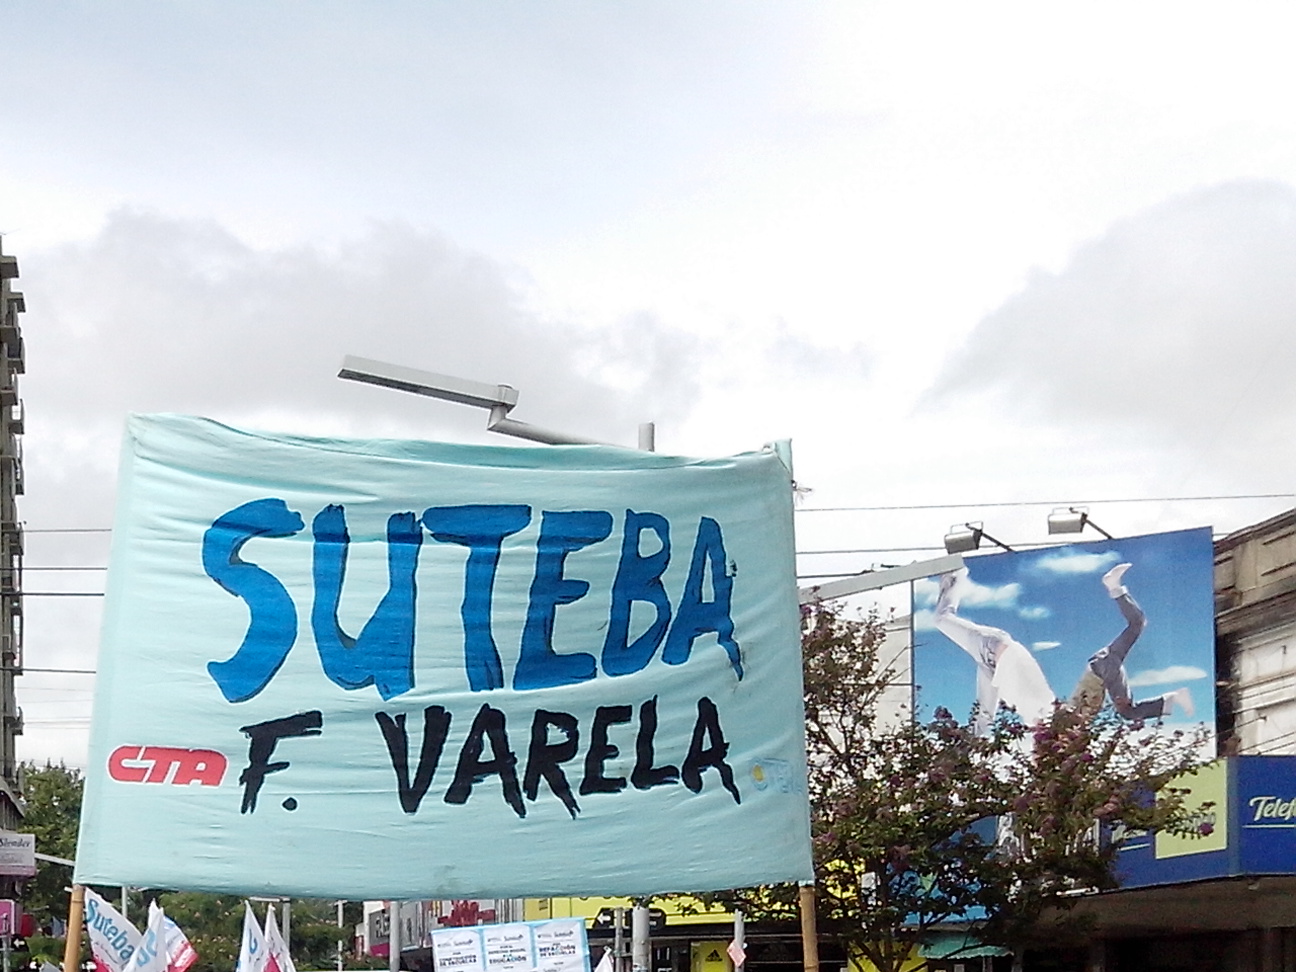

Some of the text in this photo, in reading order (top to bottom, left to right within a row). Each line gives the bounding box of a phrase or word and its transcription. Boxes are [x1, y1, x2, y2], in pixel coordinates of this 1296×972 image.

[203, 498, 743, 702] SUTEBA
[107, 745, 227, 786] CTA
[239, 695, 740, 819] F. VARELA
[84, 898, 135, 961] Suteba
